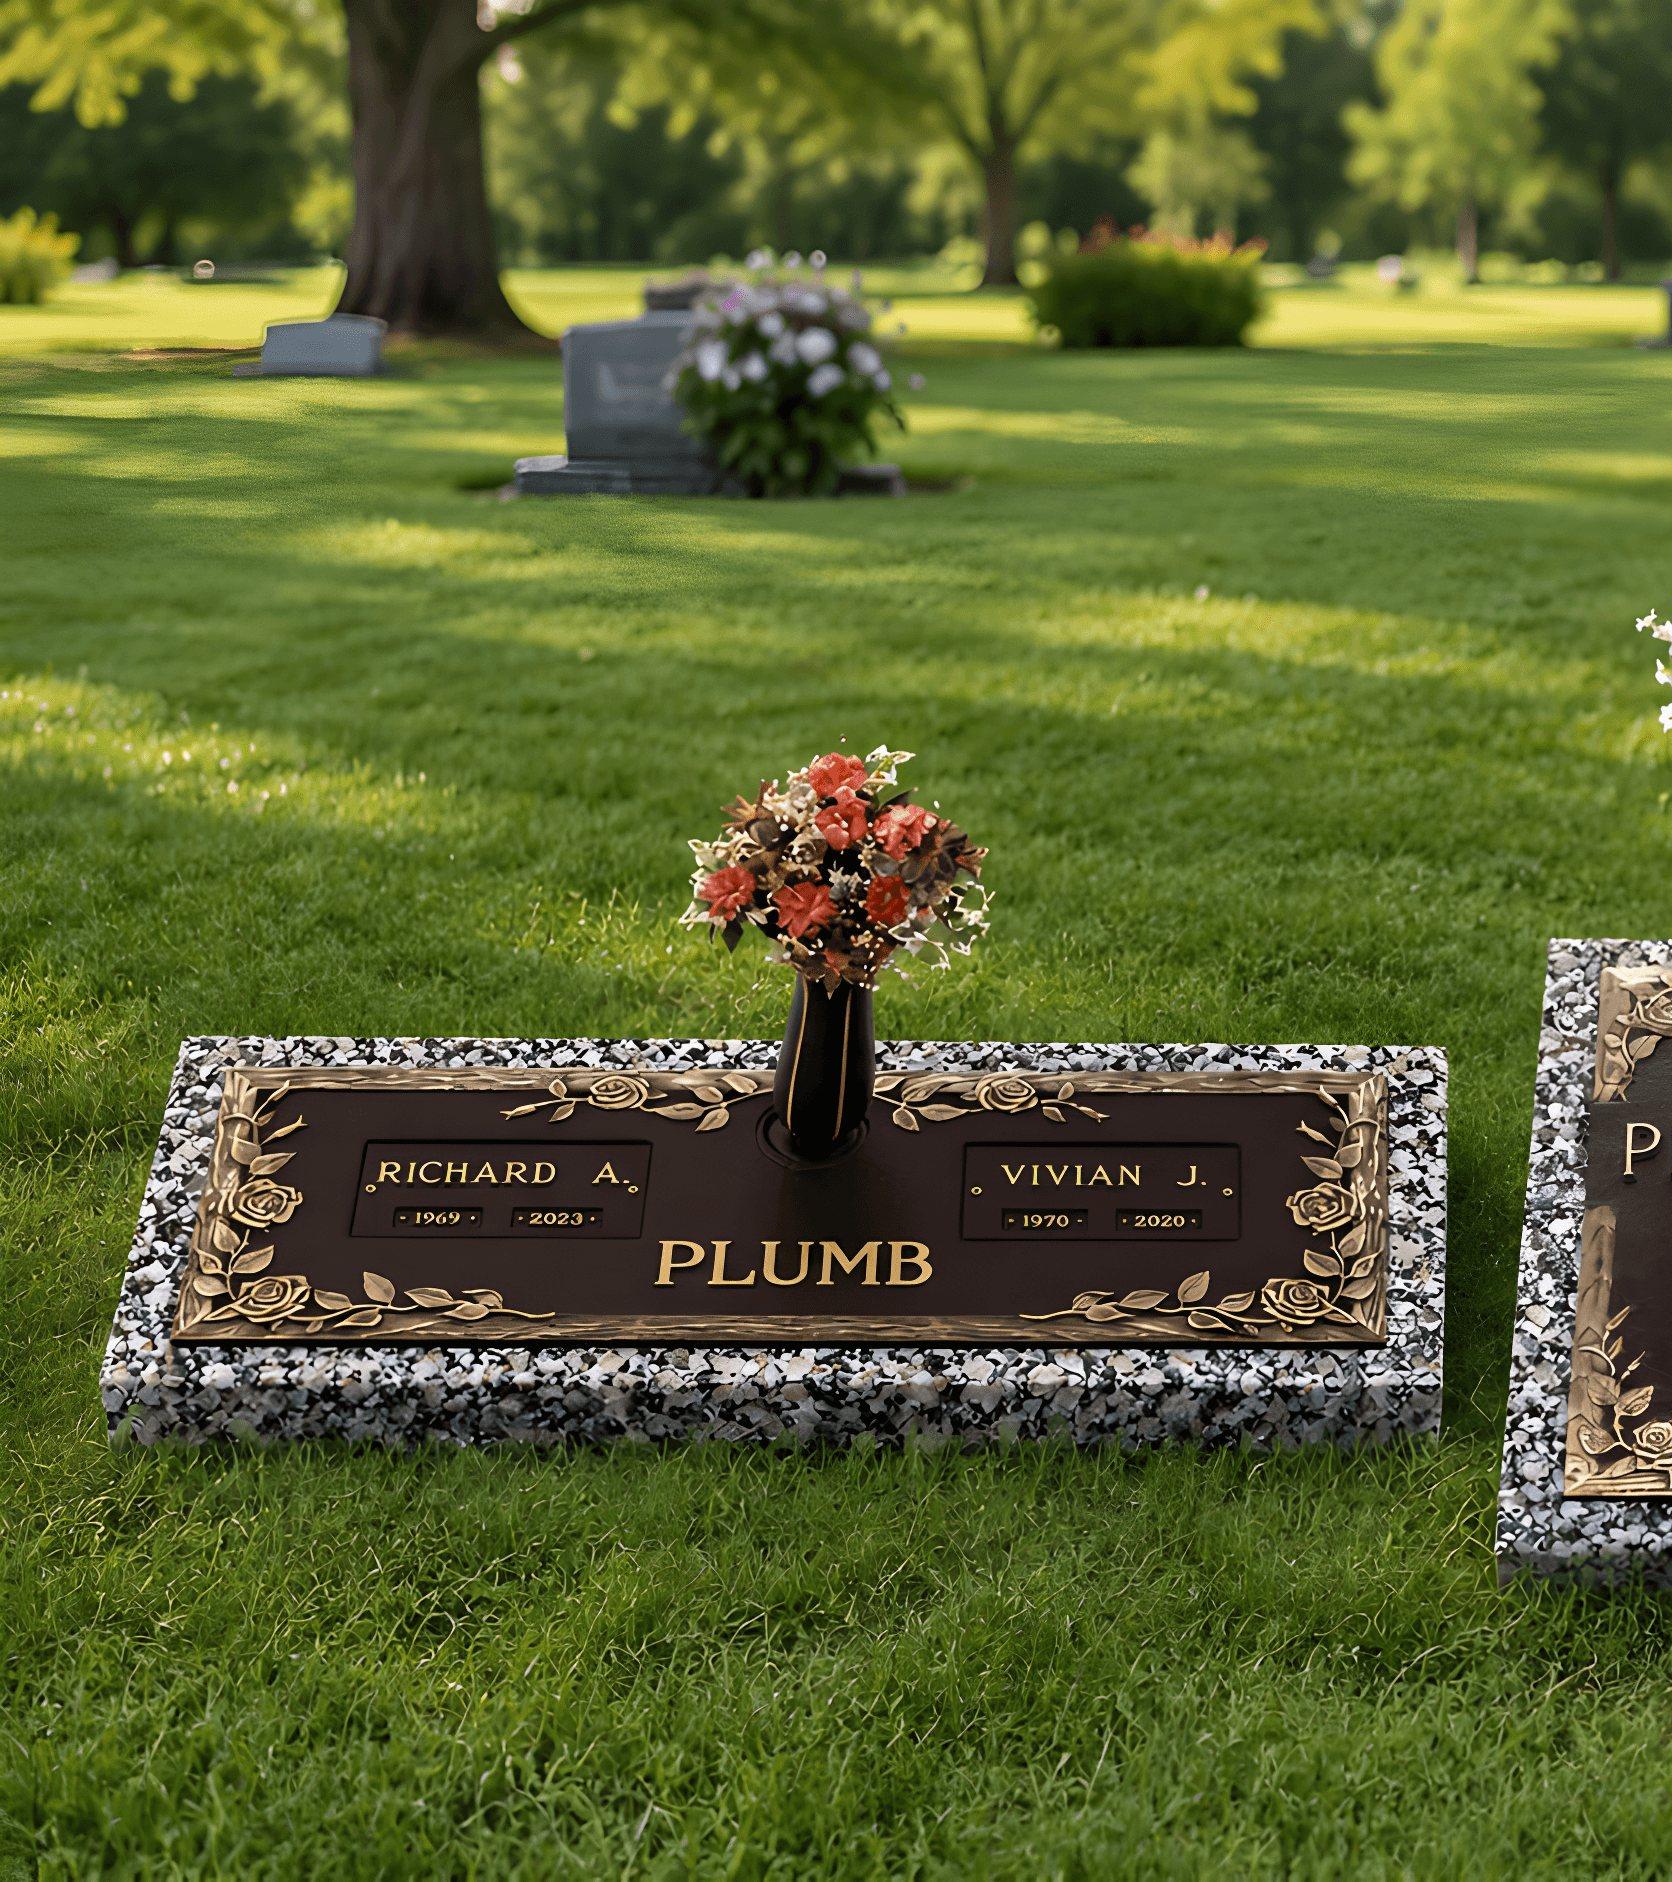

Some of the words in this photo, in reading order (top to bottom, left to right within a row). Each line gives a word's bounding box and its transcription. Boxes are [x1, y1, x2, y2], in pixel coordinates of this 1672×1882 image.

[376, 1160, 557, 1184] RICHARD
[591, 1161, 631, 1184] A.
[1000, 1164, 1142, 1186] VIVIAN
[1176, 1165, 1207, 1187] J.
[415, 1211, 461, 1225] 1969
[529, 1212, 583, 1226] 2023
[1023, 1214, 1069, 1228] 1970
[1133, 1214, 1186, 1228] 2020
[653, 1240, 933, 1286] PLUMB
